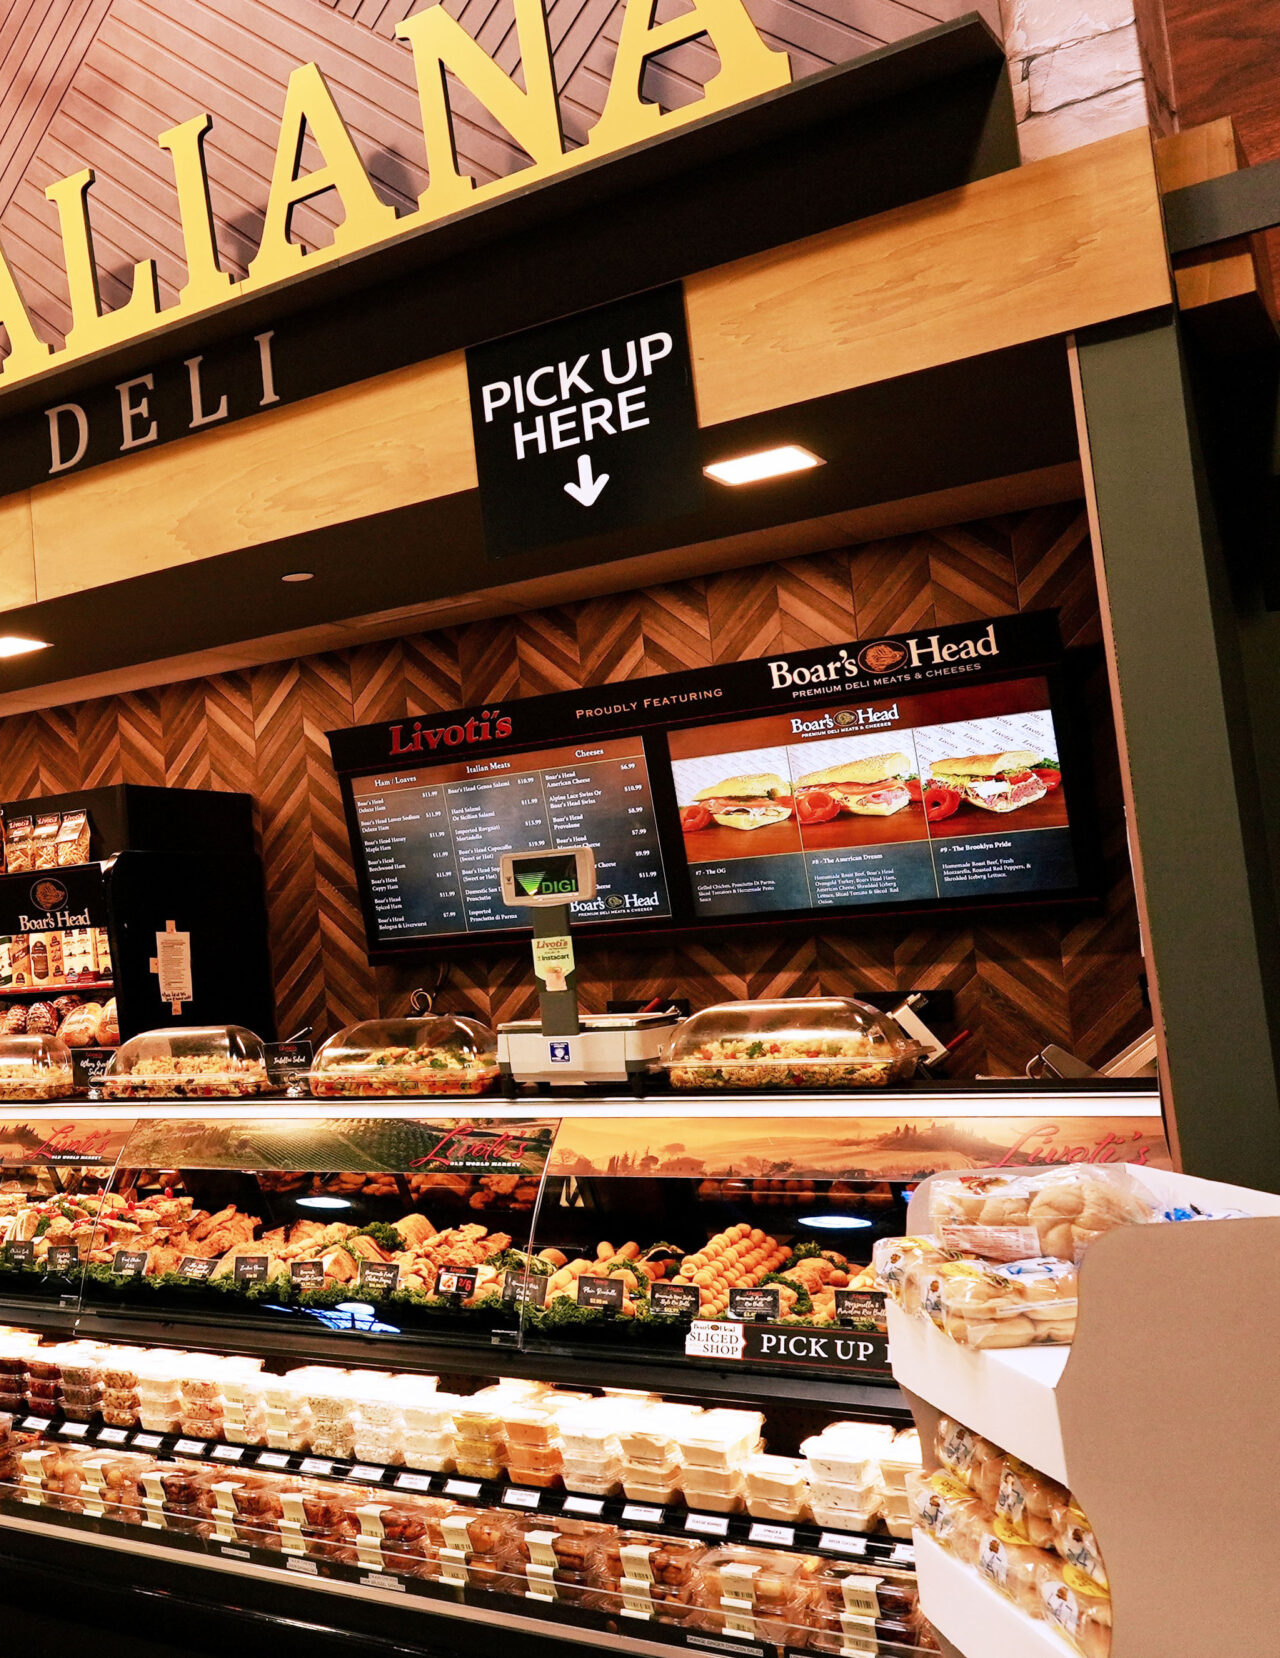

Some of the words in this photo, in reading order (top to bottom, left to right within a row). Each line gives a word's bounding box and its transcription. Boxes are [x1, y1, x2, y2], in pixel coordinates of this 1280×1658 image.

[481, 353, 593, 423] PICK
[601, 330, 673, 381] UP
[44, 330, 282, 474] DELI
[512, 389, 651, 461] HERE
[767, 650, 859, 690] Boar's
[906, 624, 999, 668] Head
[792, 684, 842, 698] PREMIUM
[845, 681, 870, 691] DELI
[874, 674, 910, 687] MEATS
[914, 672, 923, 680] &
[925, 662, 982, 679] CHEESES
[576, 701, 638, 719] PROUDLY
[643, 688, 723, 709] FEATURING
[389, 710, 513, 756] Livoti's
[790, 713, 834, 734] Boar's
[857, 703, 900, 724] Head
[466, 764, 489, 774] Italian
[489, 761, 511, 771] Meats
[575, 748, 605, 758] Cheeses
[374, 778, 391, 787] Ham
[394, 775, 417, 785] Loaves
[952, 844, 965, 852] The
[965, 842, 994, 851] Brooklyn
[542, 879, 577, 894] DIGI
[570, 896, 606, 913] Boar's
[625, 891, 660, 908] Head
[19, 912, 56, 931] Boar's
[57, 907, 91, 929] Head
[23, 1124, 111, 1160] Livoti's
[409, 1123, 528, 1168] Livoti's
[689, 1331, 739, 1345] SLICED
[702, 1343, 739, 1355] SHOP
[760, 1333, 829, 1358] PICK
[835, 1339, 874, 1361] UP
